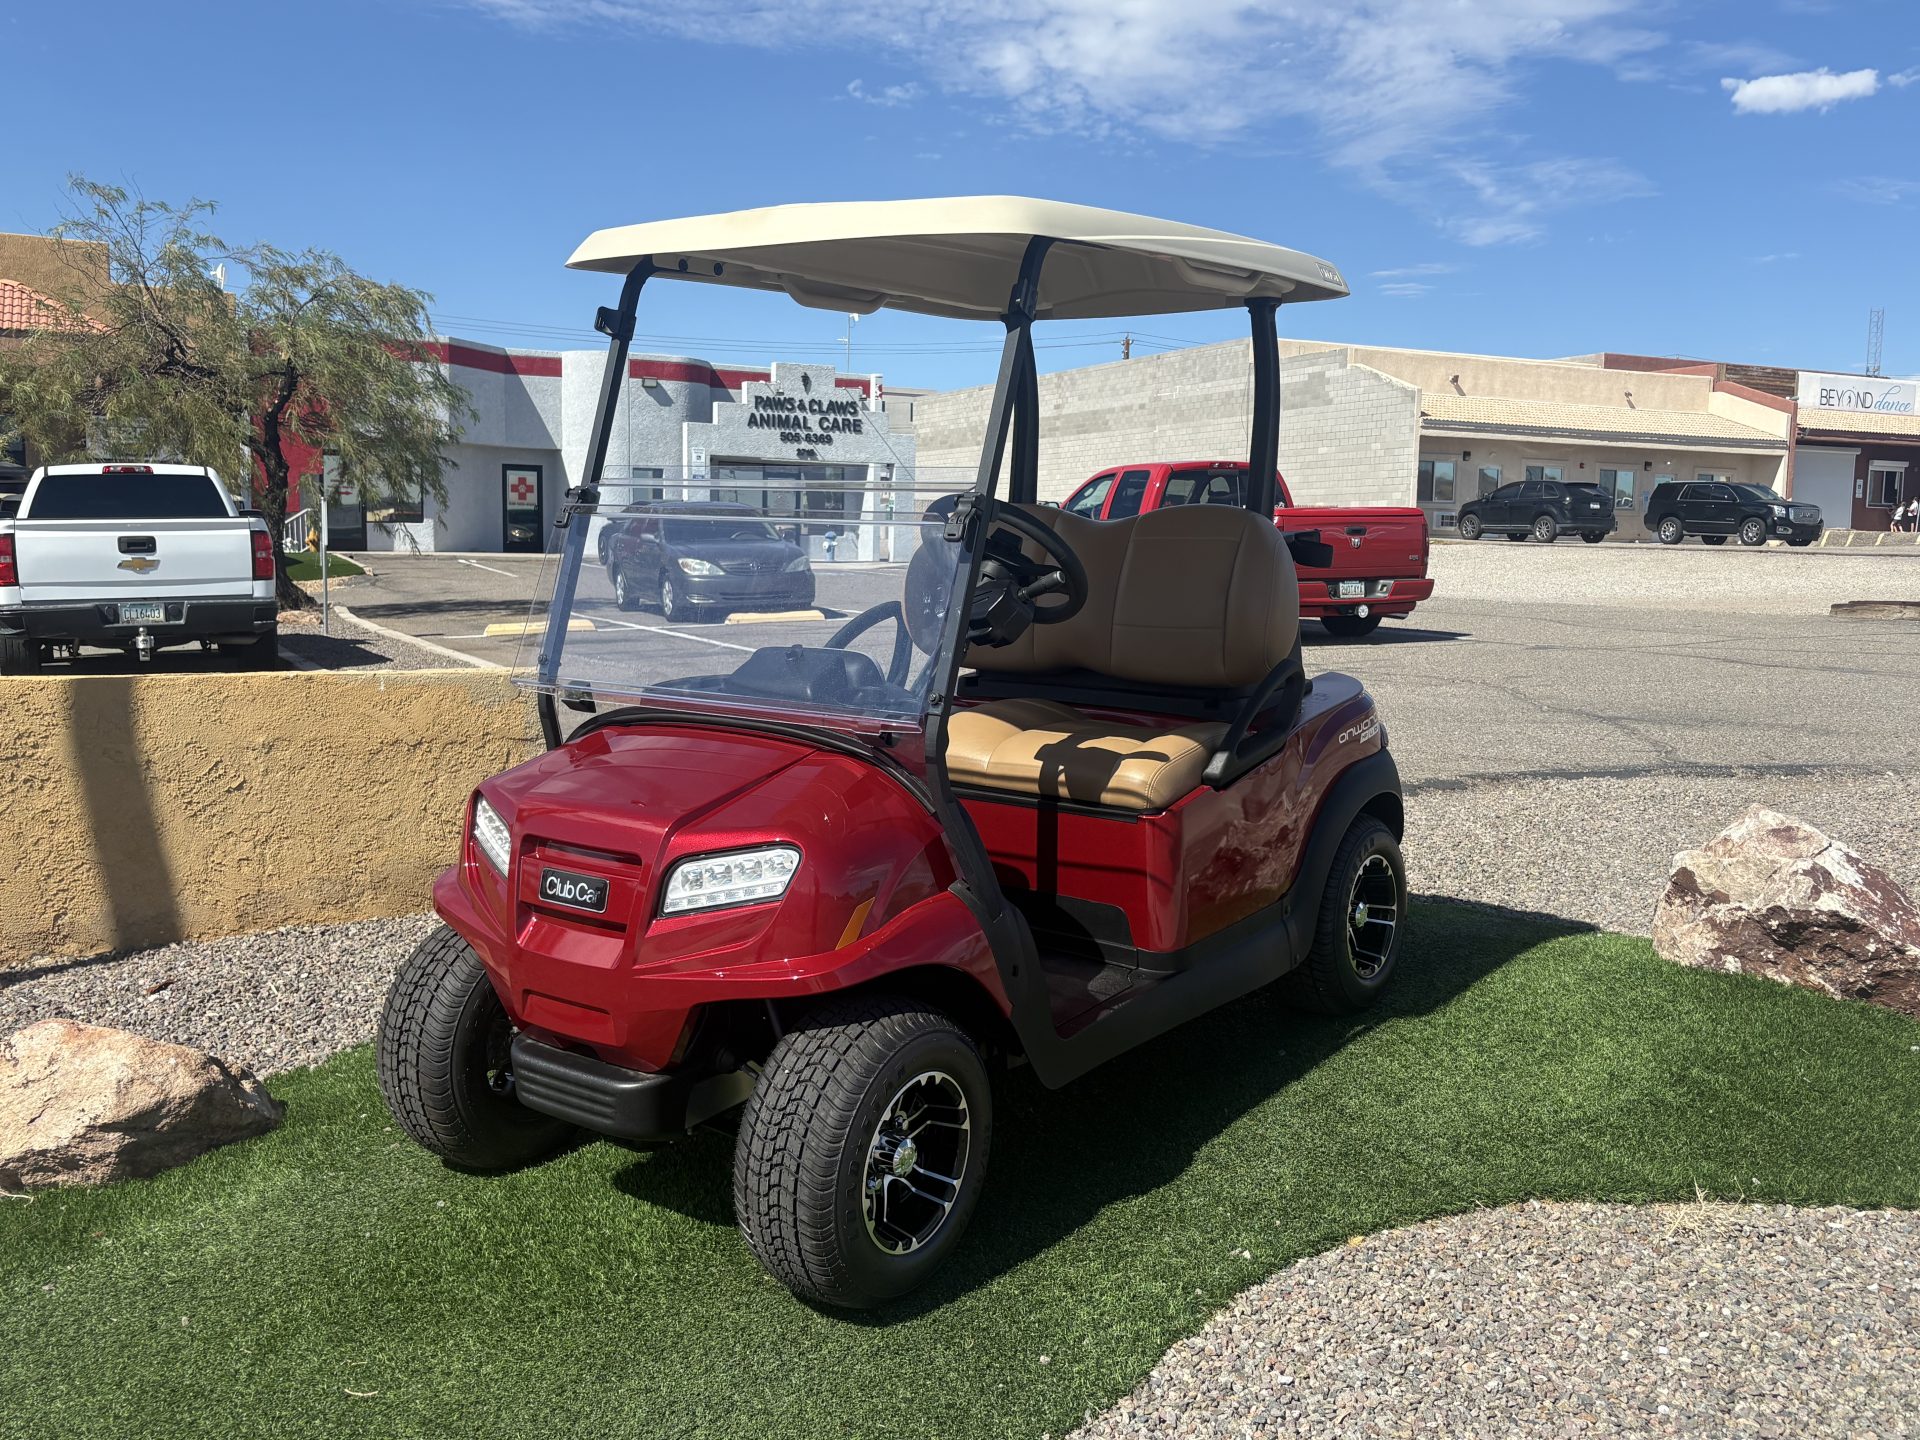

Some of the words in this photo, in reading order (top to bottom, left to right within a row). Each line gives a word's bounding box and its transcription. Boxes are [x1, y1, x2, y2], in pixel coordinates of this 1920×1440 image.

[754, 396, 795, 413] PAWS
[798, 398, 807, 413] &
[808, 399, 859, 417] CLAWS
[1874, 385, 1912, 413] dance
[748, 412, 811, 431] ANIMAL
[819, 417, 863, 434] CARE
[546, 876, 575, 899] Club
[576, 882, 601, 903] Car
